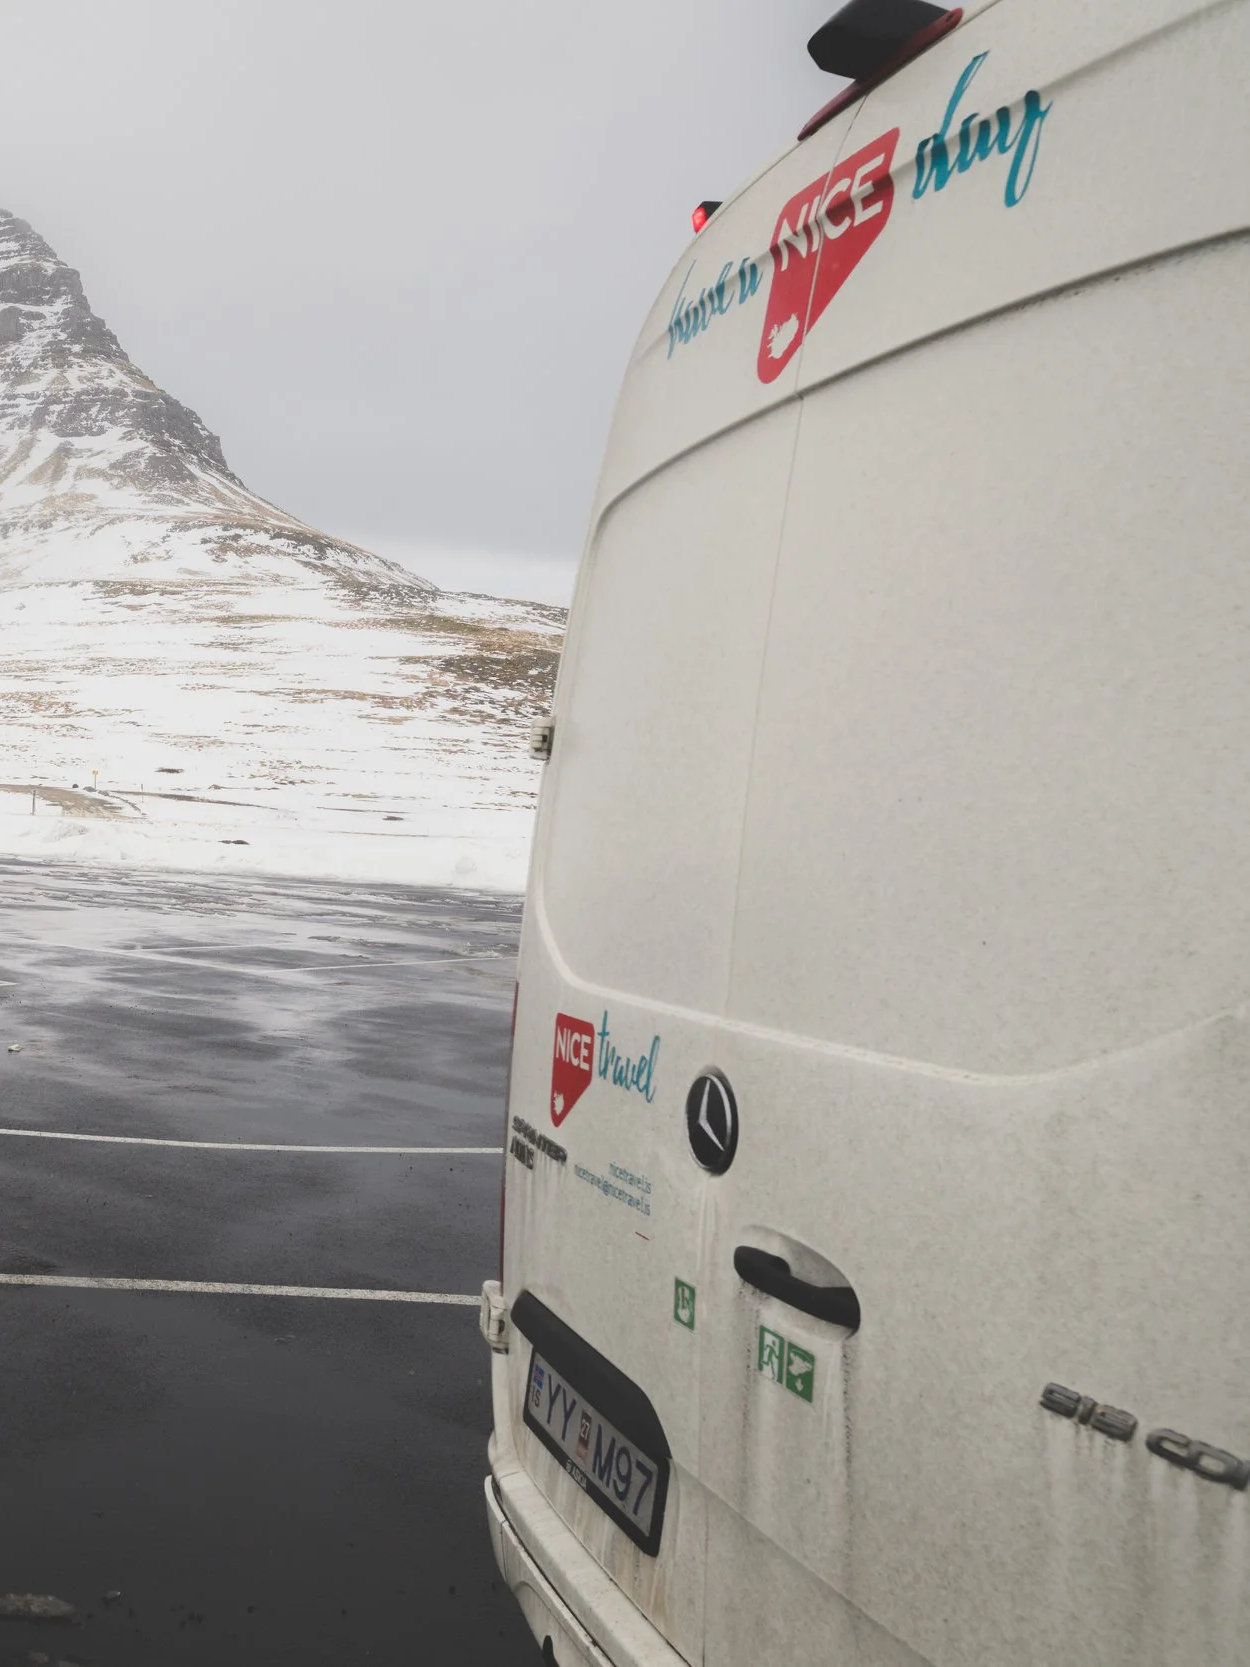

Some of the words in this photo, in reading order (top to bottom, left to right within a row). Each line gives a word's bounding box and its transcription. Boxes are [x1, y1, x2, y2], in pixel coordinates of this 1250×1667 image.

[774, 152, 884, 271] NICE
[913, 50, 1053, 208] day
[556, 1026, 591, 1071] NICE
[597, 1010, 660, 1103] travel
